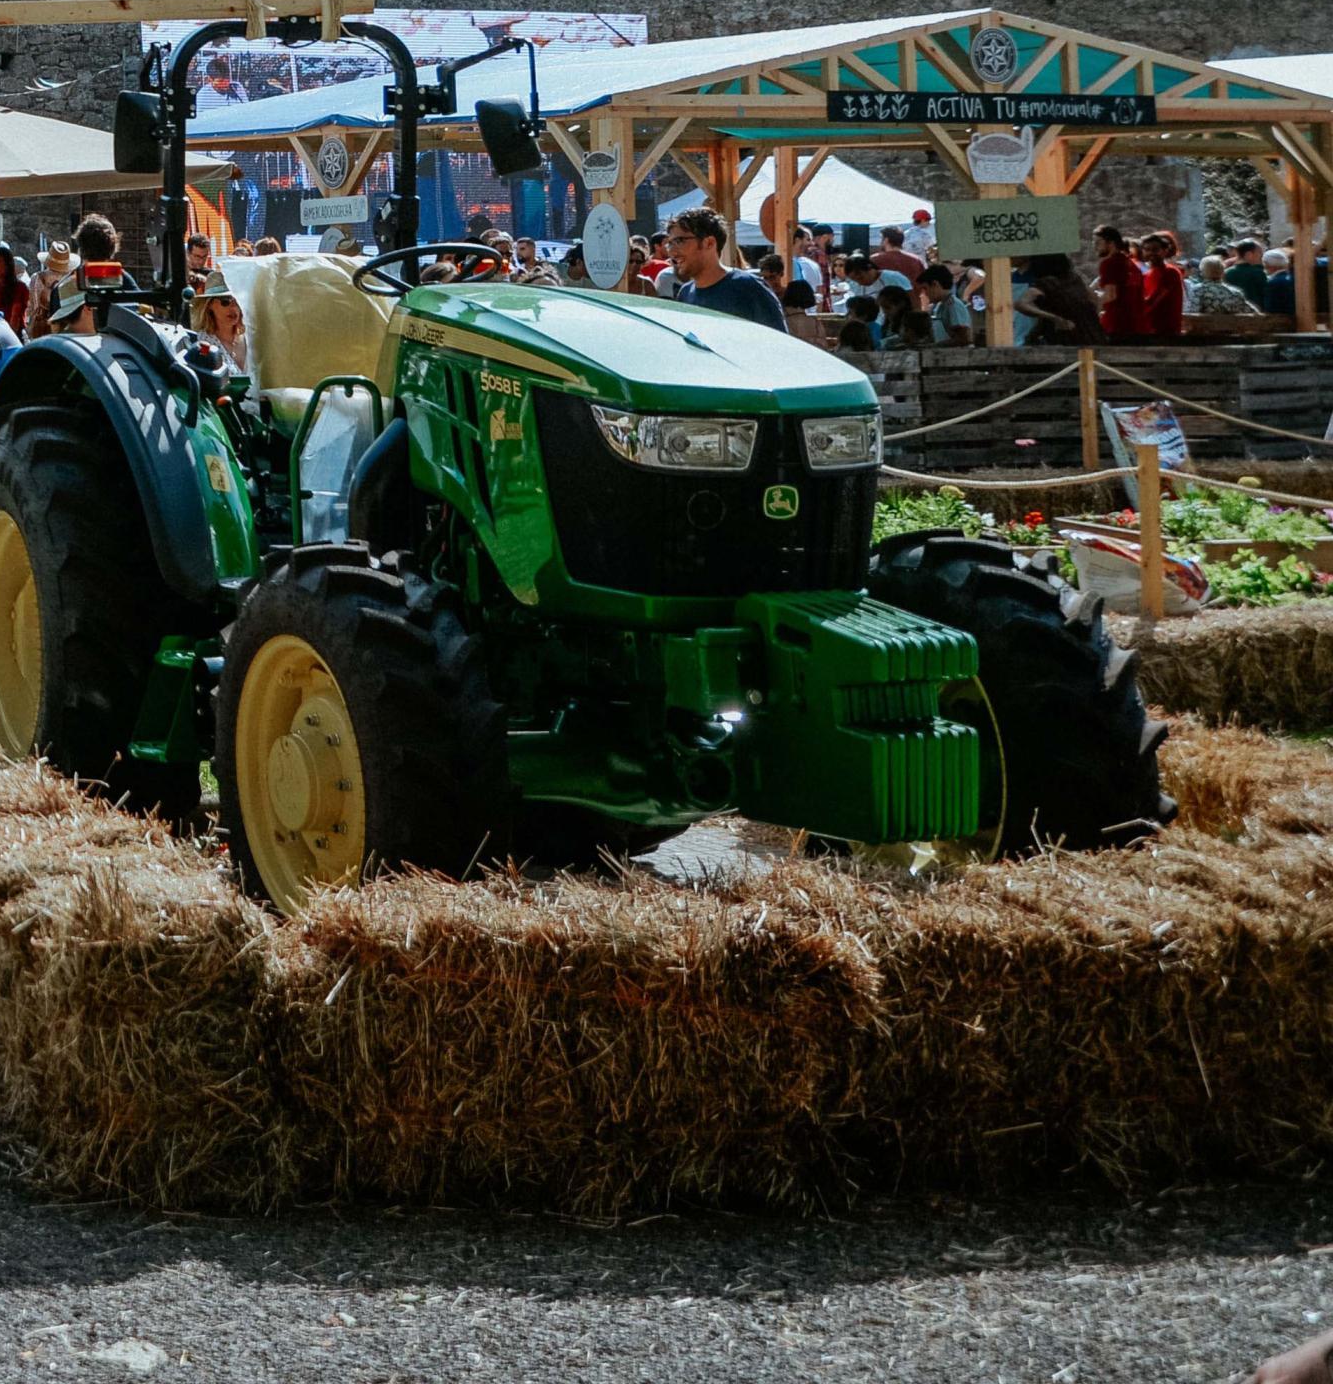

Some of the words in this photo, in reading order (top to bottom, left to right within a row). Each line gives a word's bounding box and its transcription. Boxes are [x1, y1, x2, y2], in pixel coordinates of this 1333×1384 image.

[992, 97, 1015, 119] TU
[973, 212, 1038, 230] MERCADO
[982, 228, 1040, 243] COSECHA
[423, 324, 445, 346] DEERE
[480, 372, 510, 395] 5058
[512, 380, 522, 398] E
